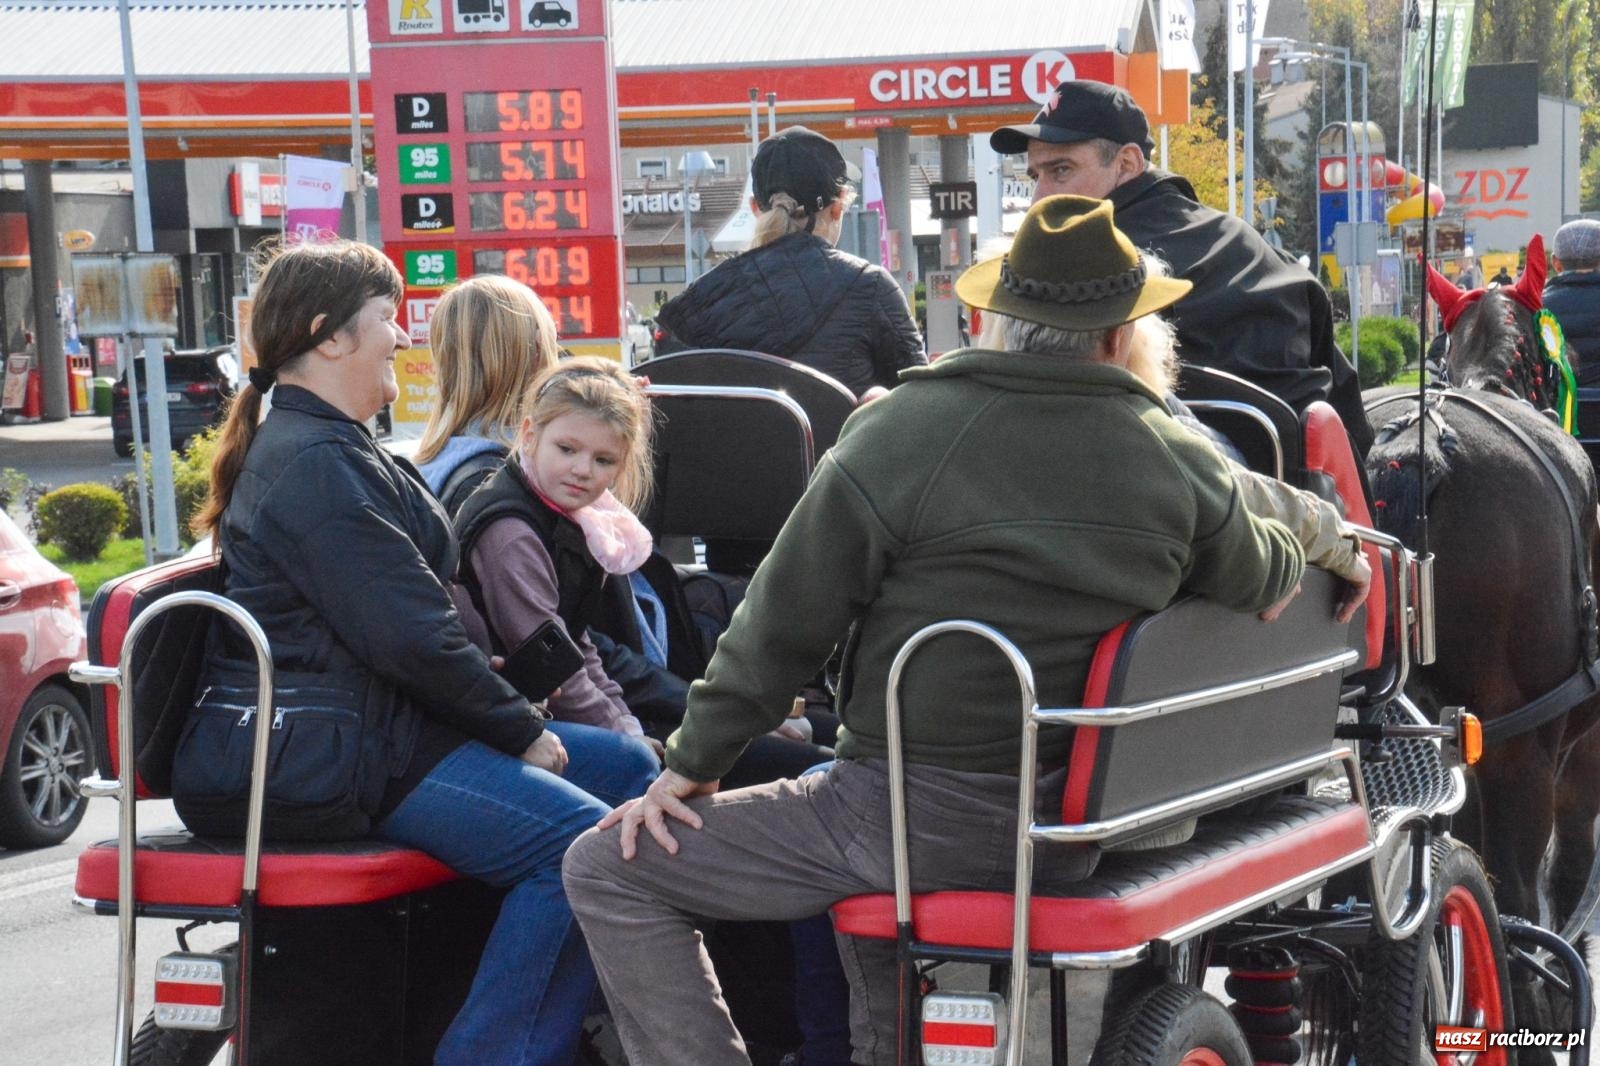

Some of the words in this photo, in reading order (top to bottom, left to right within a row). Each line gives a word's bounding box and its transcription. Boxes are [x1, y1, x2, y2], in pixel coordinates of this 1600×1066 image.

[870, 64, 1011, 102] CIRCLE
[1036, 60, 1065, 94] K
[412, 97, 430, 117] D
[497, 91, 583, 132] 5.89
[411, 120, 434, 129] miles
[410, 147, 439, 168] 95
[502, 140, 586, 181] 5.74
[414, 171, 437, 179] miles
[1455, 167, 1530, 204] ZDZ
[419, 197, 436, 217] D
[504, 191, 588, 231] 6.24
[935, 191, 974, 211] TIR
[417, 254, 445, 274] 95
[505, 246, 590, 286] 6.09
